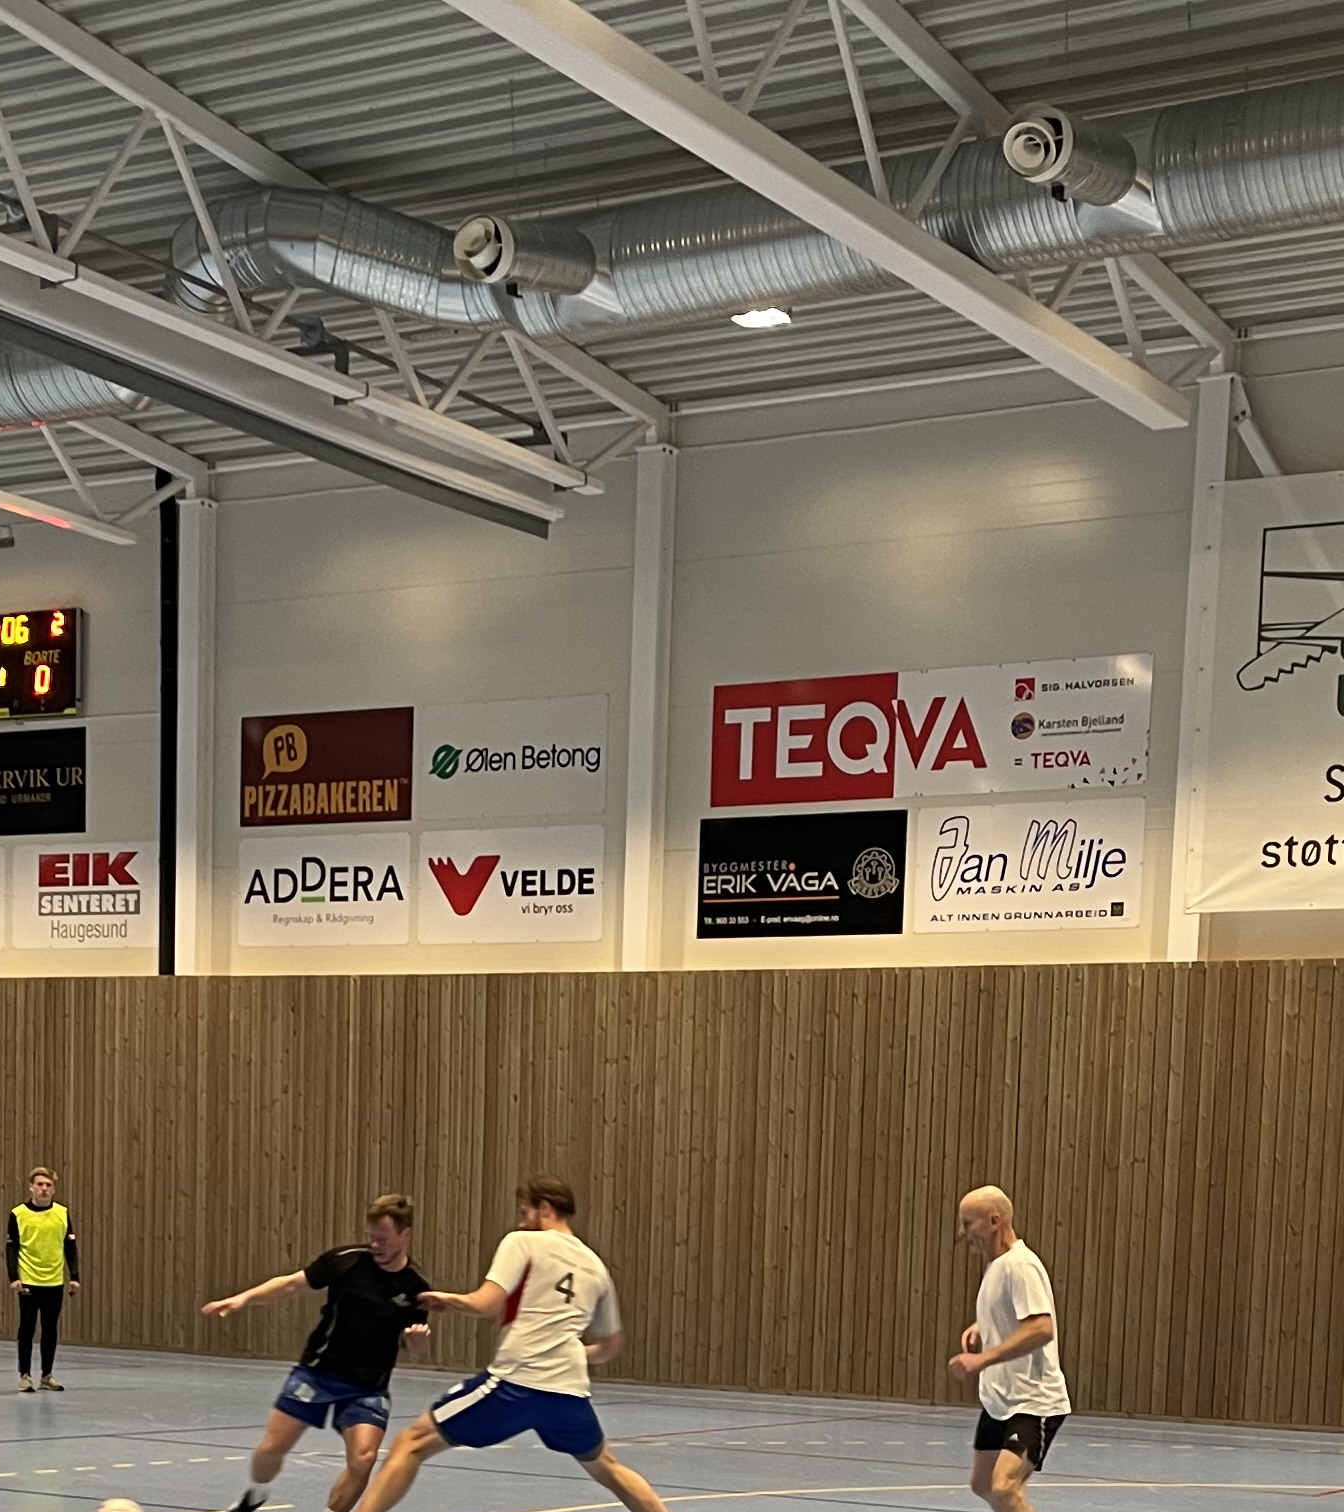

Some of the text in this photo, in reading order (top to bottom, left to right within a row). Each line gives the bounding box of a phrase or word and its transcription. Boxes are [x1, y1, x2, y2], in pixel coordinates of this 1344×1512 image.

[24, 649, 61, 666] BORTE
[34, 664, 51, 695] 0
[1065, 677, 1135, 690] HALVORSEN
[1038, 713, 1125, 729] Karsten Bjelland
[273, 732, 298, 767] PB
[724, 696, 987, 781] TEQVA
[464, 744, 601, 774] Ølen Betong
[1031, 750, 1091, 769] TEQVA
[56, 766, 84, 787] UR
[244, 779, 399, 818] PIZZABAKEREN
[38, 851, 139, 888] EIK
[703, 860, 788, 873] BYGGMESTER
[931, 816, 1127, 901] Jan Milje
[244, 857, 405, 904] ADDERA
[500, 867, 595, 897] VELDE
[703, 873, 757, 894] ERIK
[956, 884, 1043, 895] MASKIN
[40, 892, 139, 915] SENTERET
[521, 902, 573, 917] vi bryr oss
[930, 909, 1108, 922] ALT INNEN GRUNNARBEID
[50, 919, 128, 943] Haugesund
[555, 1272, 576, 1304] 4
